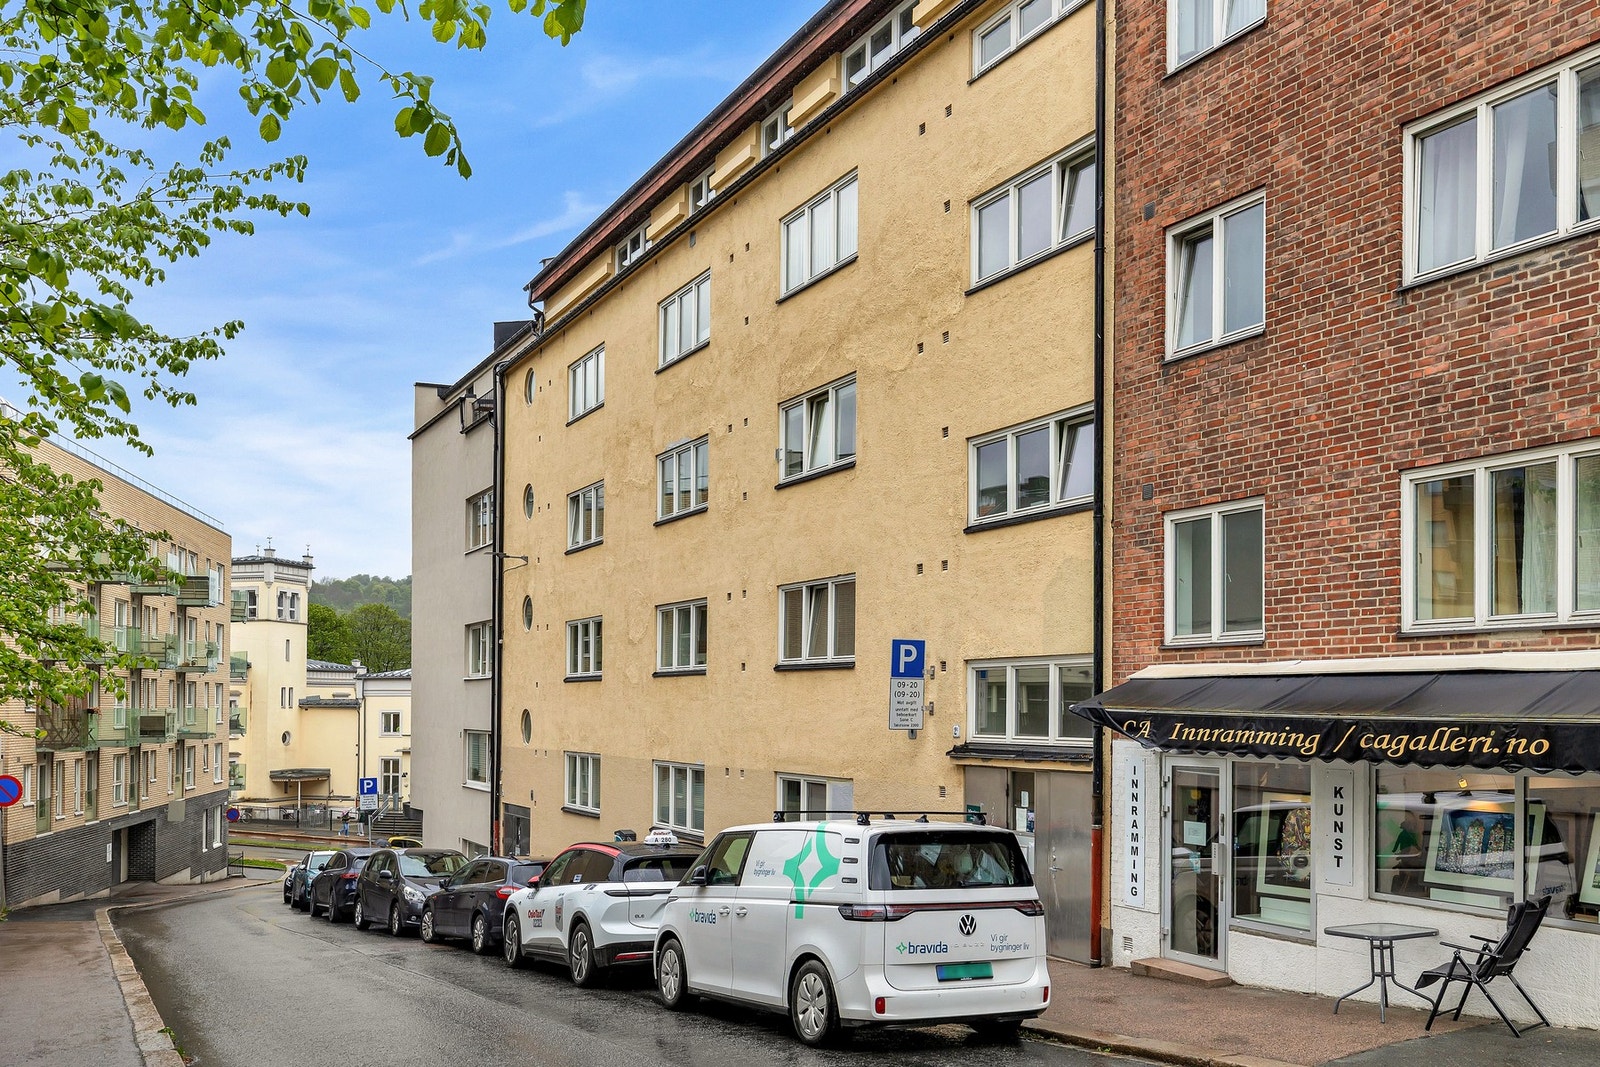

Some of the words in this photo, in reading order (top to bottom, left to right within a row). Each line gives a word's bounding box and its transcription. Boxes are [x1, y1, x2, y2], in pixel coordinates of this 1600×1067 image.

[899, 644, 917, 673] P
[1123, 720, 1152, 739] CA
[1168, 722, 1321, 756] Innramming
[1359, 726, 1550, 758] cagalleri.no
[364, 780, 374, 793] P
[1130, 765, 1139, 897] INNRAMMING
[1333, 786, 1344, 868] KUNST
[694, 908, 717, 924] bravida
[990, 934, 998, 942] Vi
[999, 933, 1009, 943] gir
[908, 941, 948, 954] bravida
[990, 943, 1023, 953] bygninger
